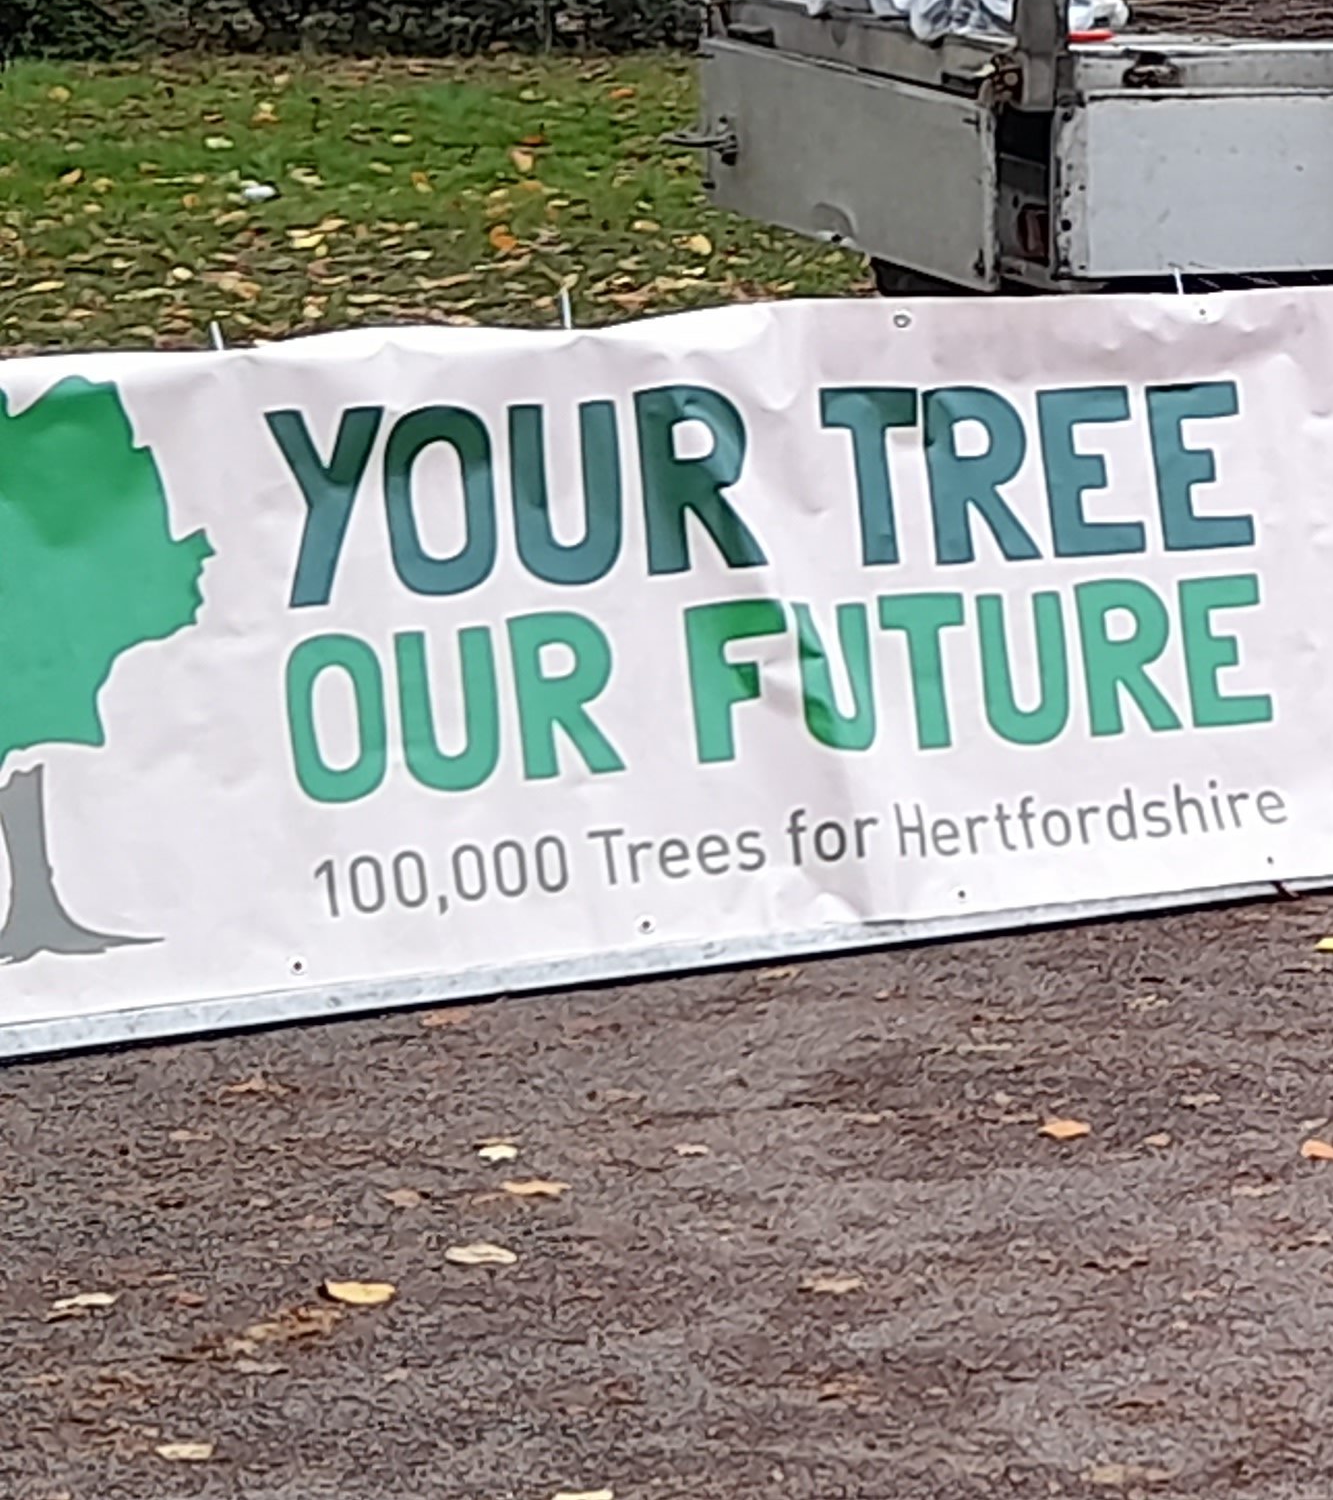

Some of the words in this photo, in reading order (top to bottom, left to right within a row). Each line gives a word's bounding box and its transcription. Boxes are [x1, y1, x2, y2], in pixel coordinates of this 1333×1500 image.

[264, 384, 769, 609] YOUR
[818, 380, 1257, 567] TREE
[285, 610, 626, 804] OUR
[682, 572, 1274, 764] FUTURE
[313, 836, 569, 917] 100,000
[588, 828, 767, 885] Trees
[786, 809, 878, 866] for
[894, 780, 1290, 859] Hertfordshire
